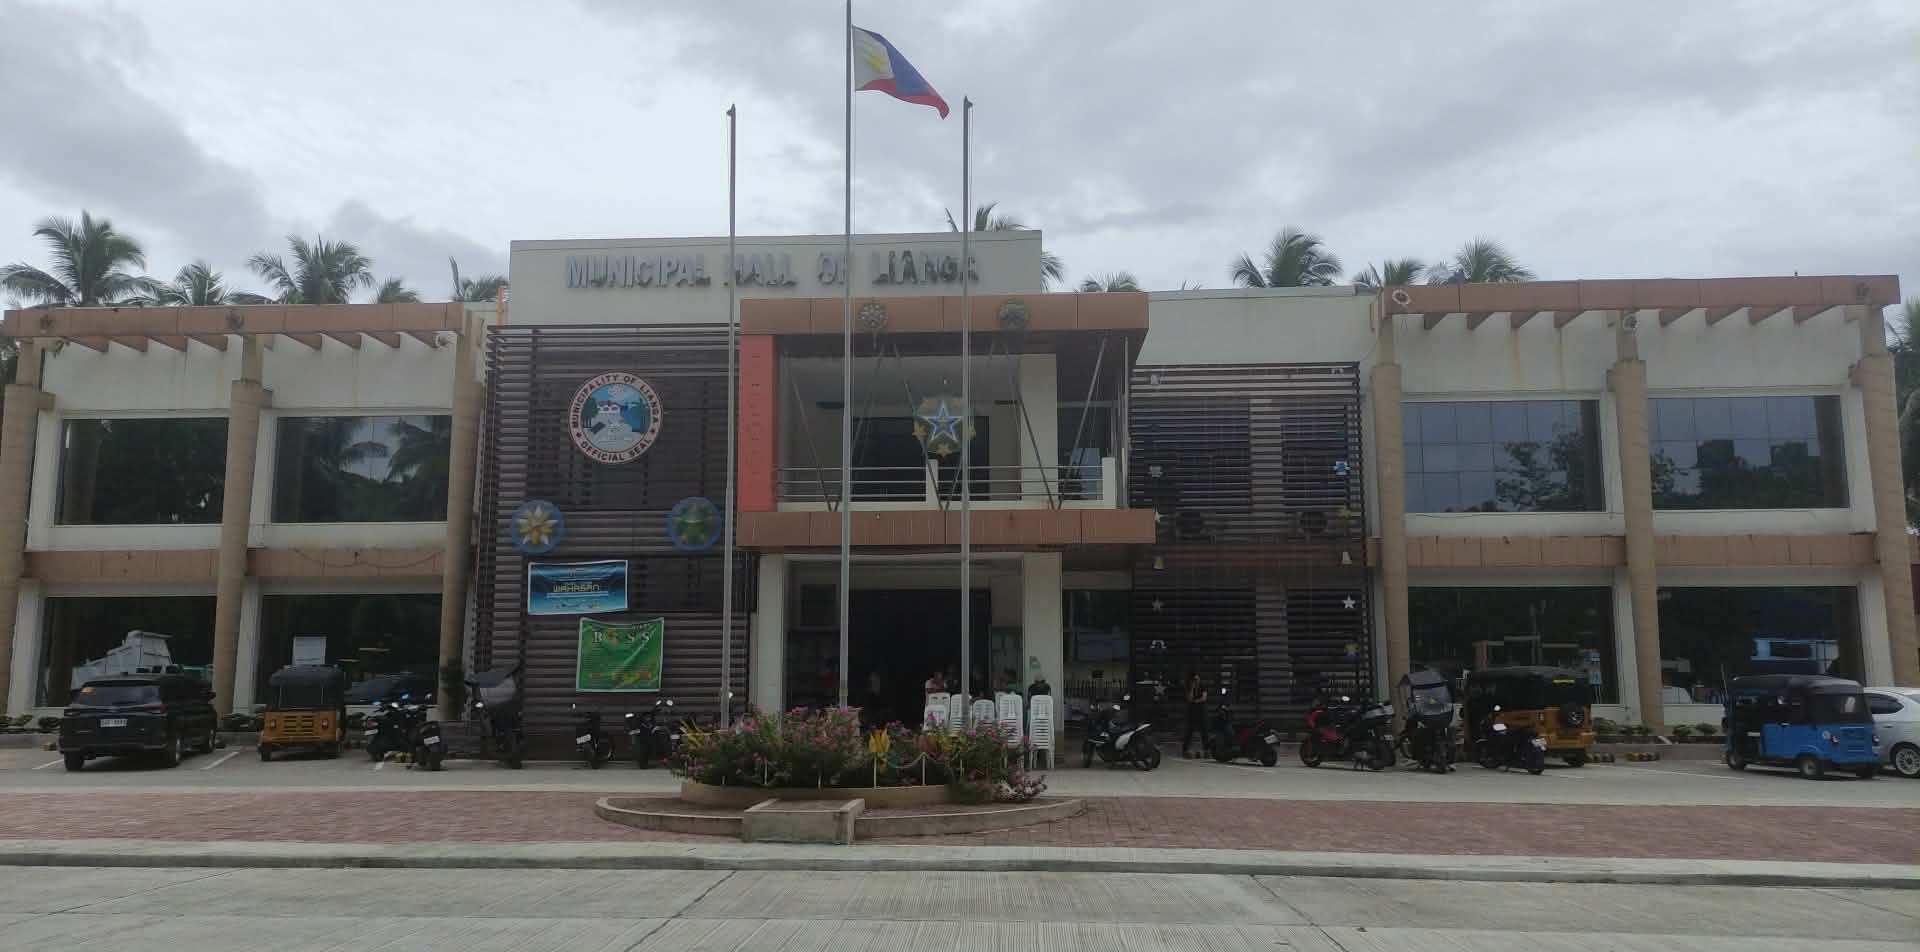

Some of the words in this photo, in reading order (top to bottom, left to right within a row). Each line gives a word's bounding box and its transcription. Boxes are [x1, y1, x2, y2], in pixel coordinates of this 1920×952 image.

[567, 254, 711, 288] MUNICIPAL
[722, 252, 799, 288] HALL
[871, 249, 979, 285] LIANGA
[571, 374, 618, 428] MUNICIPALITY
[623, 375, 638, 385] OF
[639, 385, 660, 424] LIANGA
[580, 441, 625, 461] OFFICIAL
[628, 438, 652, 457] SEAL
